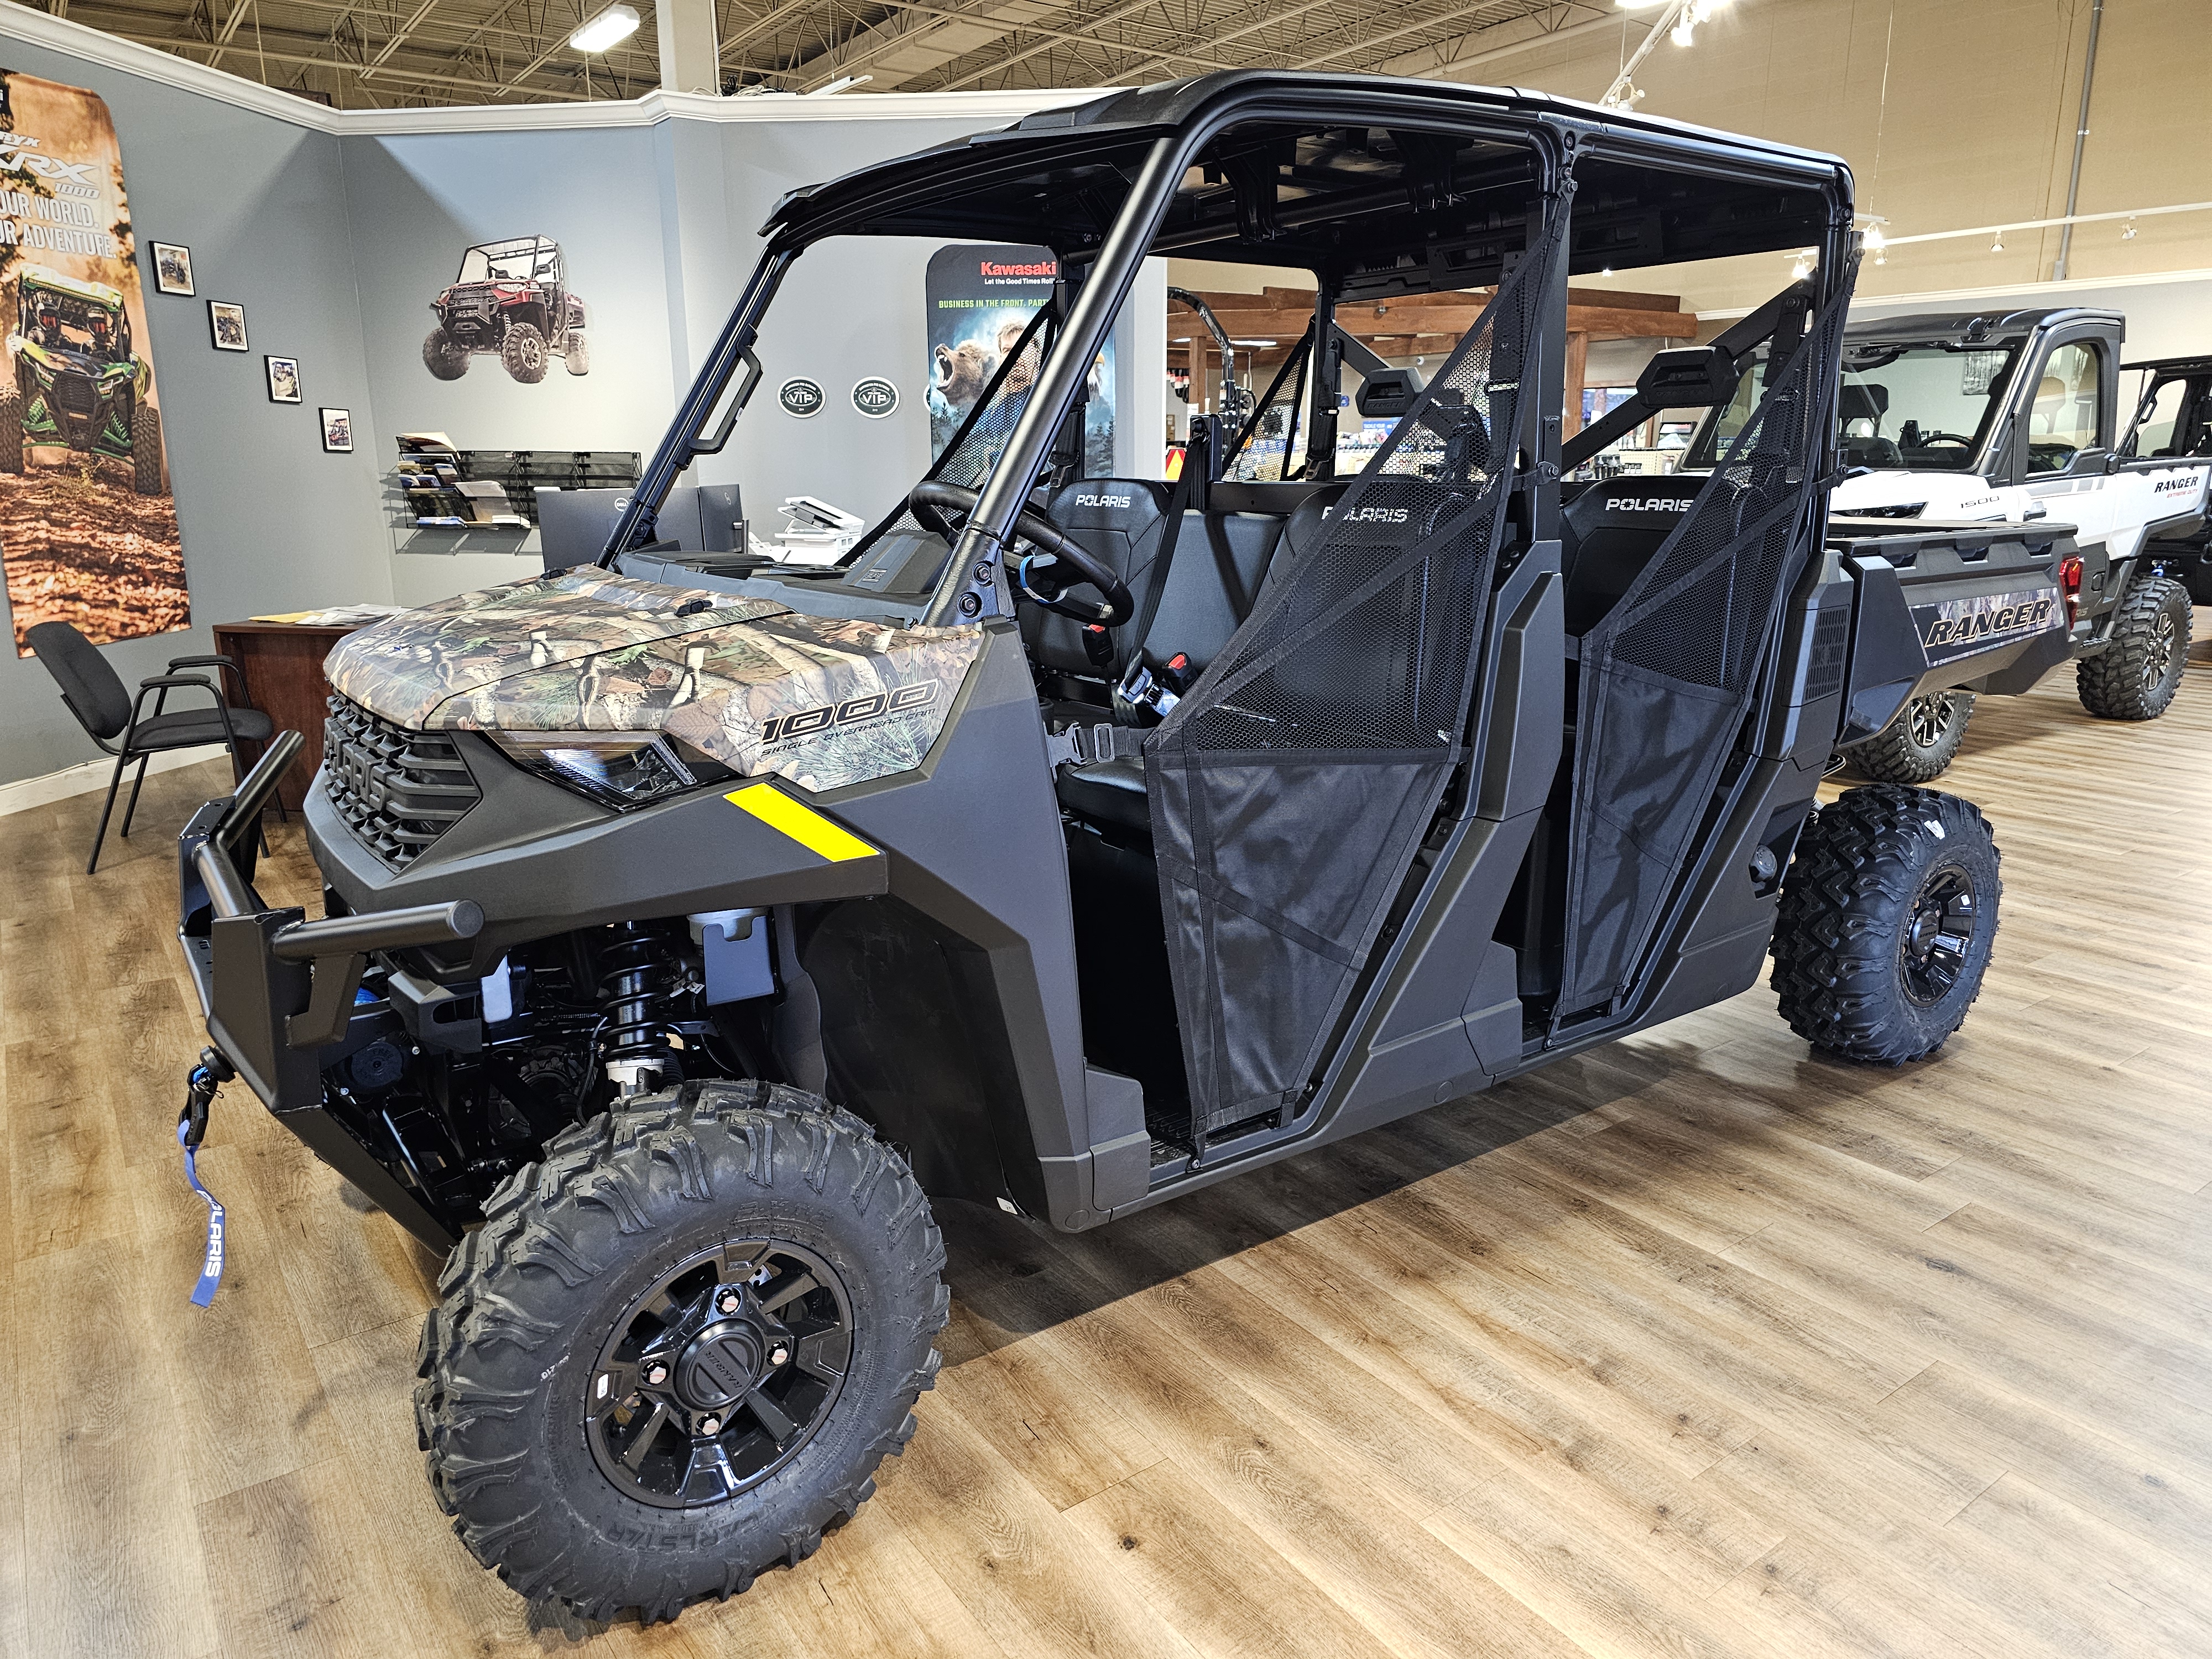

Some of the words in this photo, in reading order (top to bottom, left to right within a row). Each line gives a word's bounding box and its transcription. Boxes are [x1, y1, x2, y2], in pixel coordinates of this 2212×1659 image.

[55, 182, 100, 199] 1000
[34, 196, 99, 228] WORLD.
[24, 223, 117, 258] ADVENTURE.
[981, 262, 1056, 275] Kawasaki
[985, 299, 999, 307] THE
[789, 394, 813, 403] VIP
[863, 394, 886, 404] VIP
[2154, 476, 2198, 493] RANGER
[1076, 494, 1131, 508] POLARIS
[1961, 496, 1999, 508] 1500
[1924, 598, 2051, 648] RANGER
[760, 679, 939, 745] 1000
[761, 737, 818, 756] SINGLE
[824, 717, 901, 740] OVERHEAD
[905, 708, 936, 719] CAM
